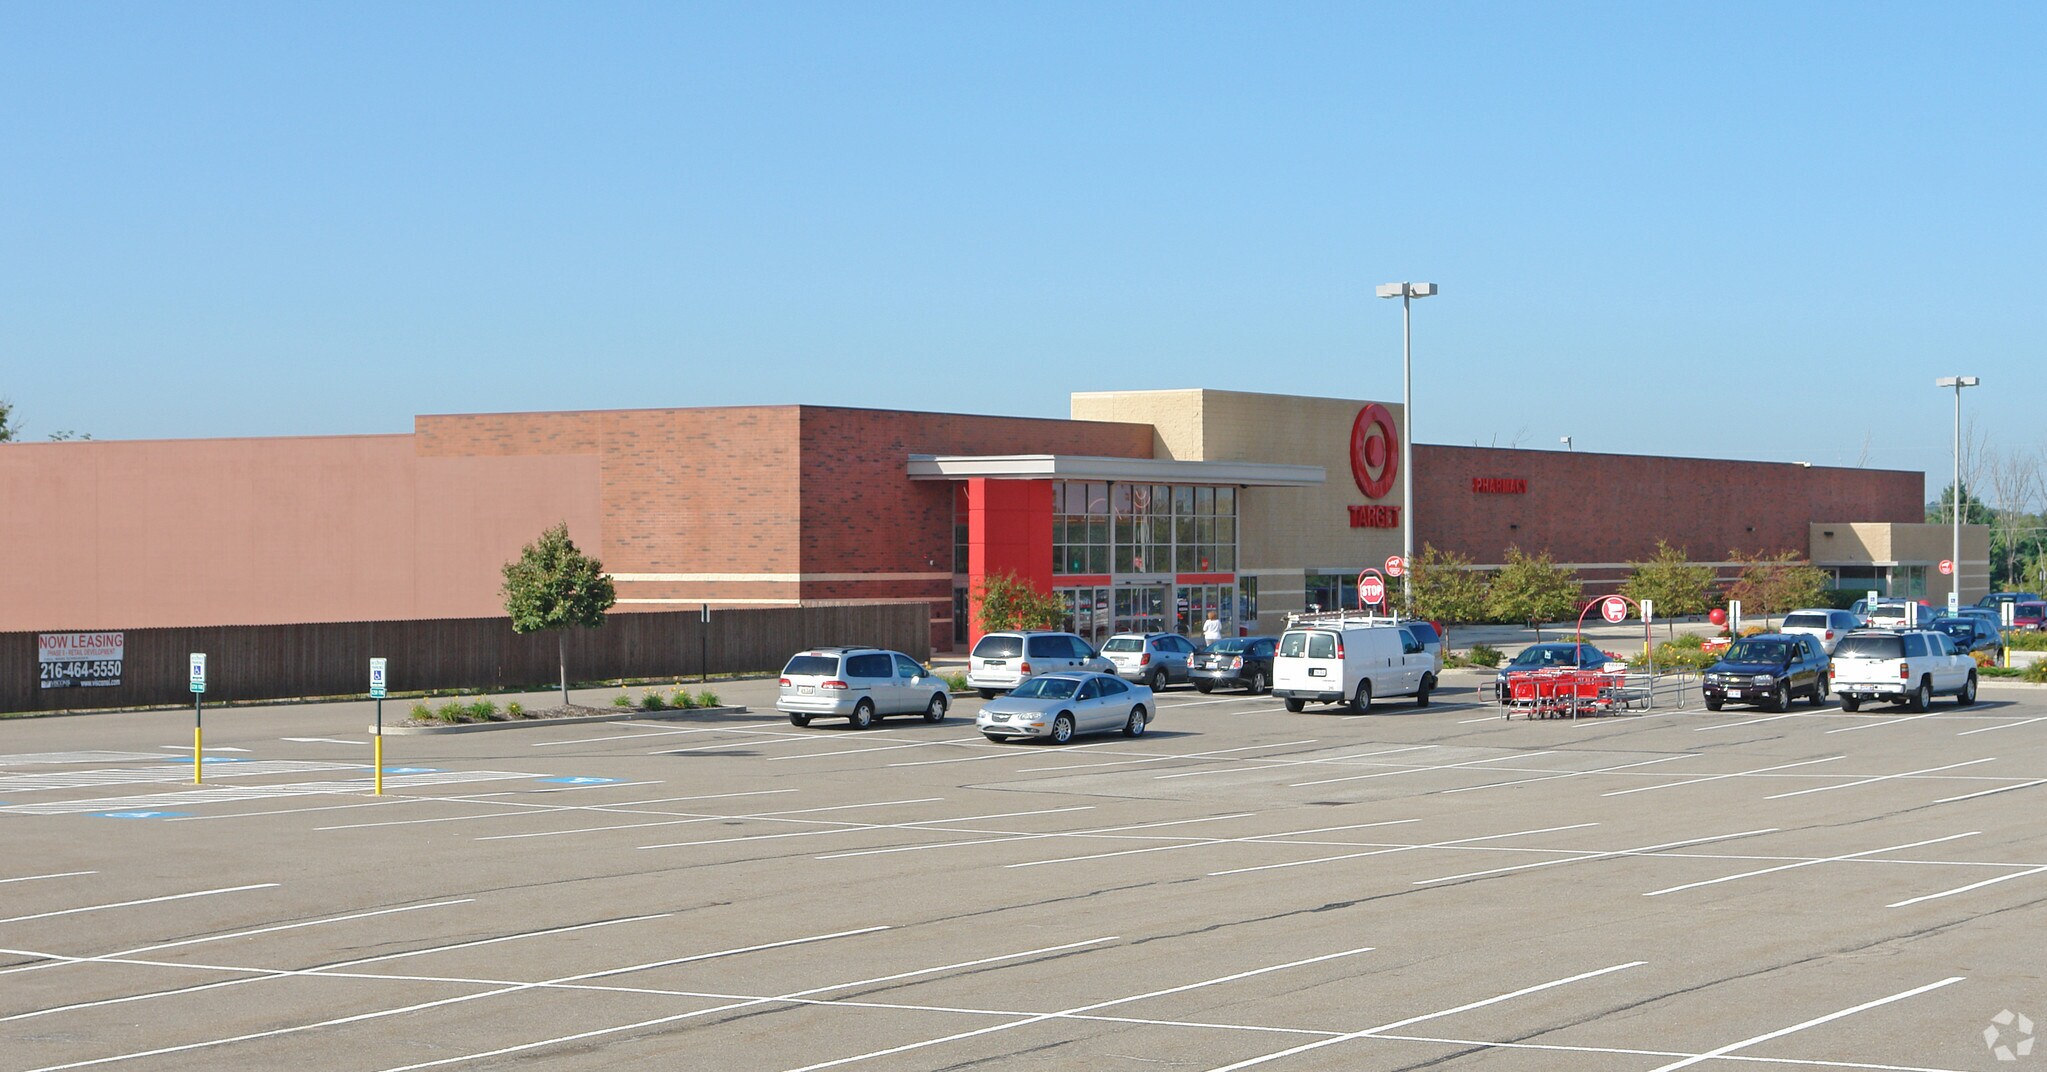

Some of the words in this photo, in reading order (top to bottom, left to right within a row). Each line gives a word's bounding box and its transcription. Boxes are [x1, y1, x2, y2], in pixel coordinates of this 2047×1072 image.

[1472, 477, 1528, 494] PHARMACY
[1347, 505, 1401, 528] TARGET
[1361, 584, 1383, 597] STOP
[40, 636, 68, 649] NOW
[71, 634, 123, 648] LEASING
[40, 661, 122, 679] 216-464-5550
